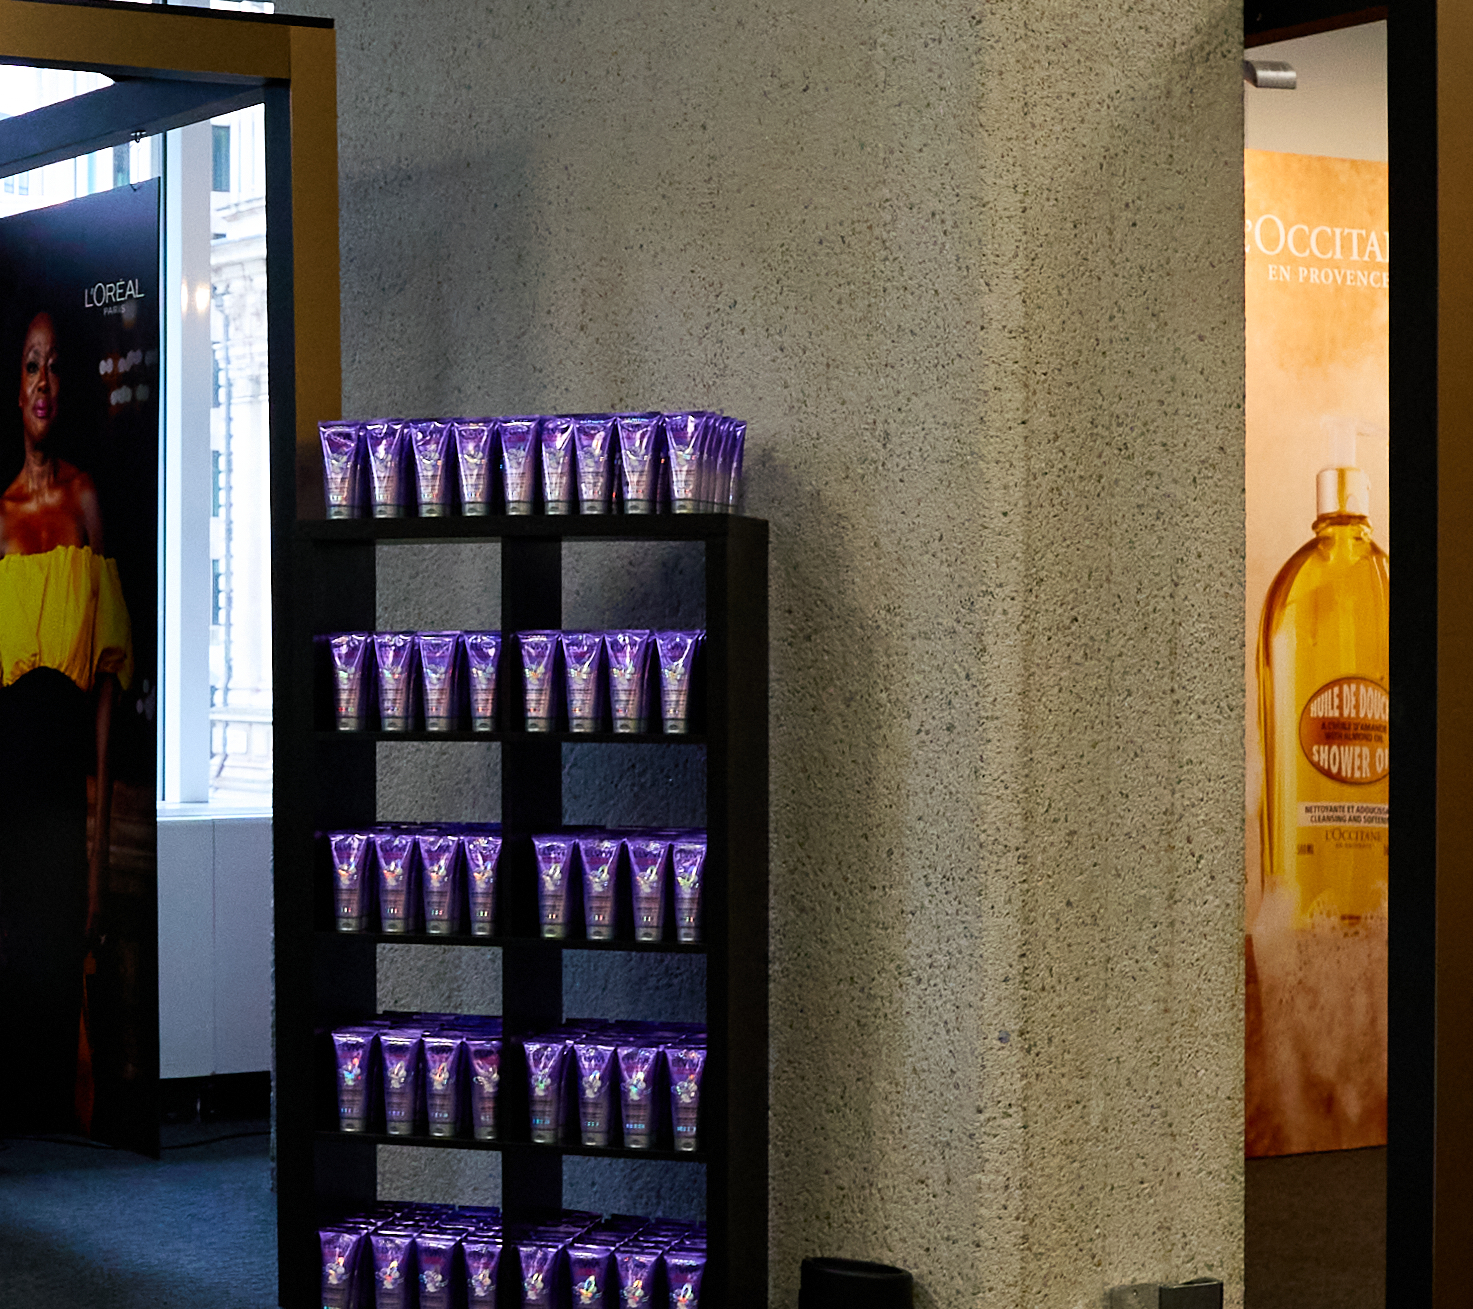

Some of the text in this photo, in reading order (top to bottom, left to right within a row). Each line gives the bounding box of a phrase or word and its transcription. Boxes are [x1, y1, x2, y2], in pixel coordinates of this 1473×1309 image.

[1245, 214, 1389, 263] 'OCCITA
[1268, 264, 1291, 282] EN
[85, 278, 145, 308] L'ORÉAL
[1310, 685, 1340, 718] HUILE
[1343, 684, 1356, 718] DE
[1312, 745, 1388, 779] SHOWER OI
[1310, 815, 1346, 823] CLEANSING
